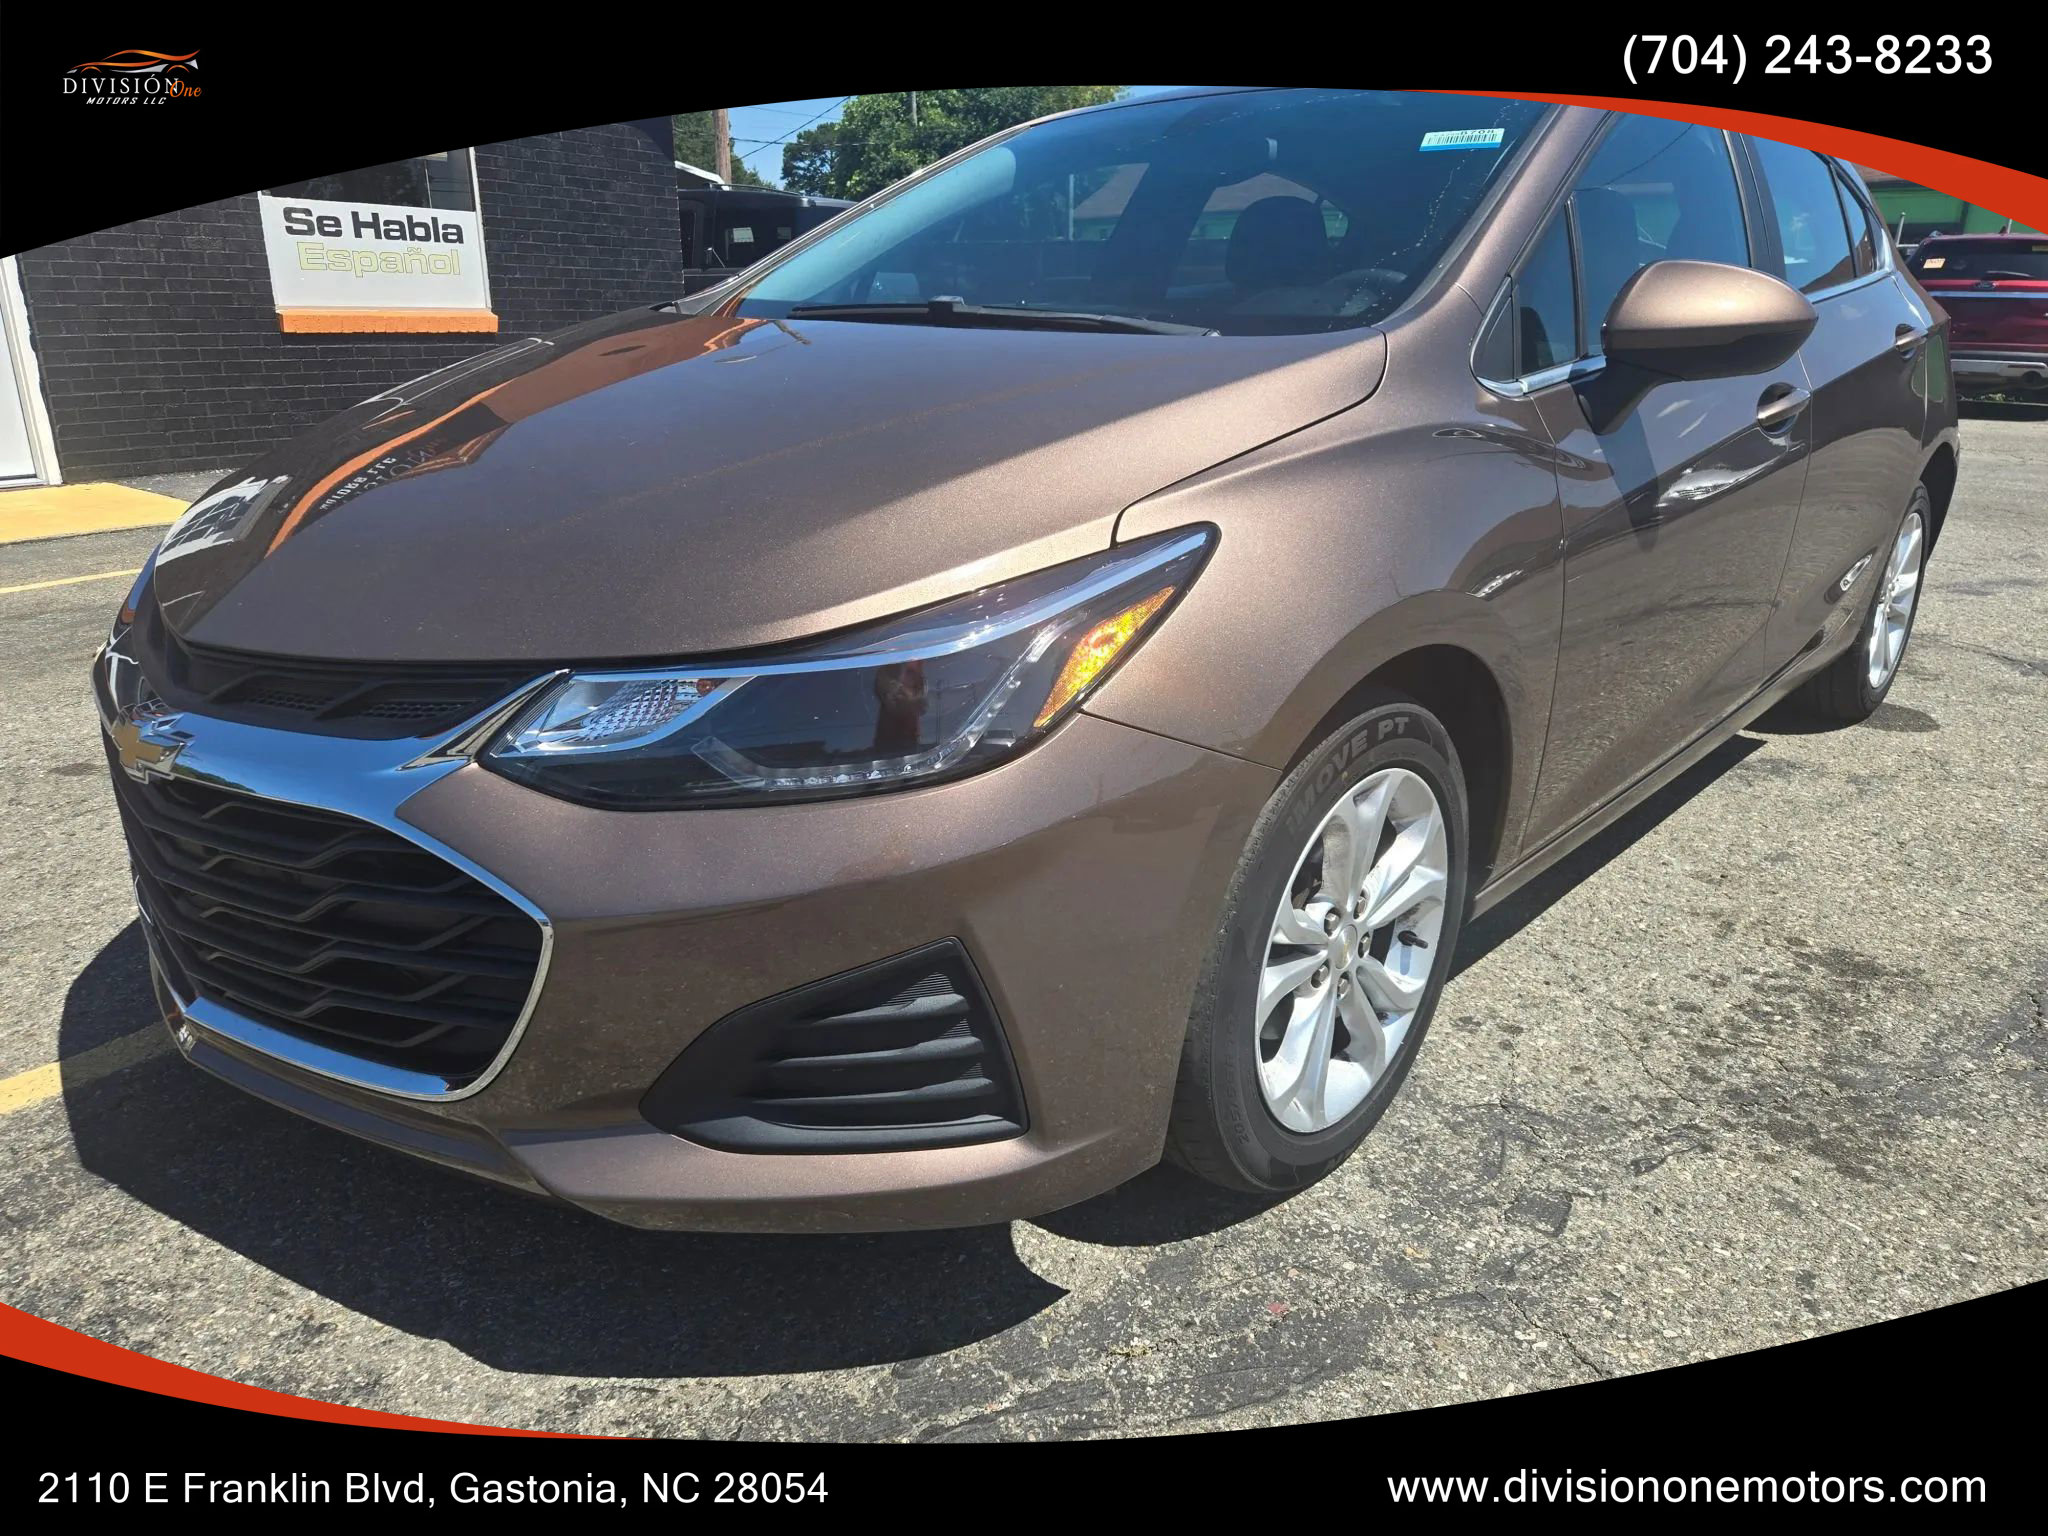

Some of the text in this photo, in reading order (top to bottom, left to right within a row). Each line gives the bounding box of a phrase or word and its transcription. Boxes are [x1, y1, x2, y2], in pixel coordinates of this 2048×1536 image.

[283, 206, 464, 244] Se Habla
[296, 241, 460, 278] Español
[1378, 716, 1409, 741] PT
